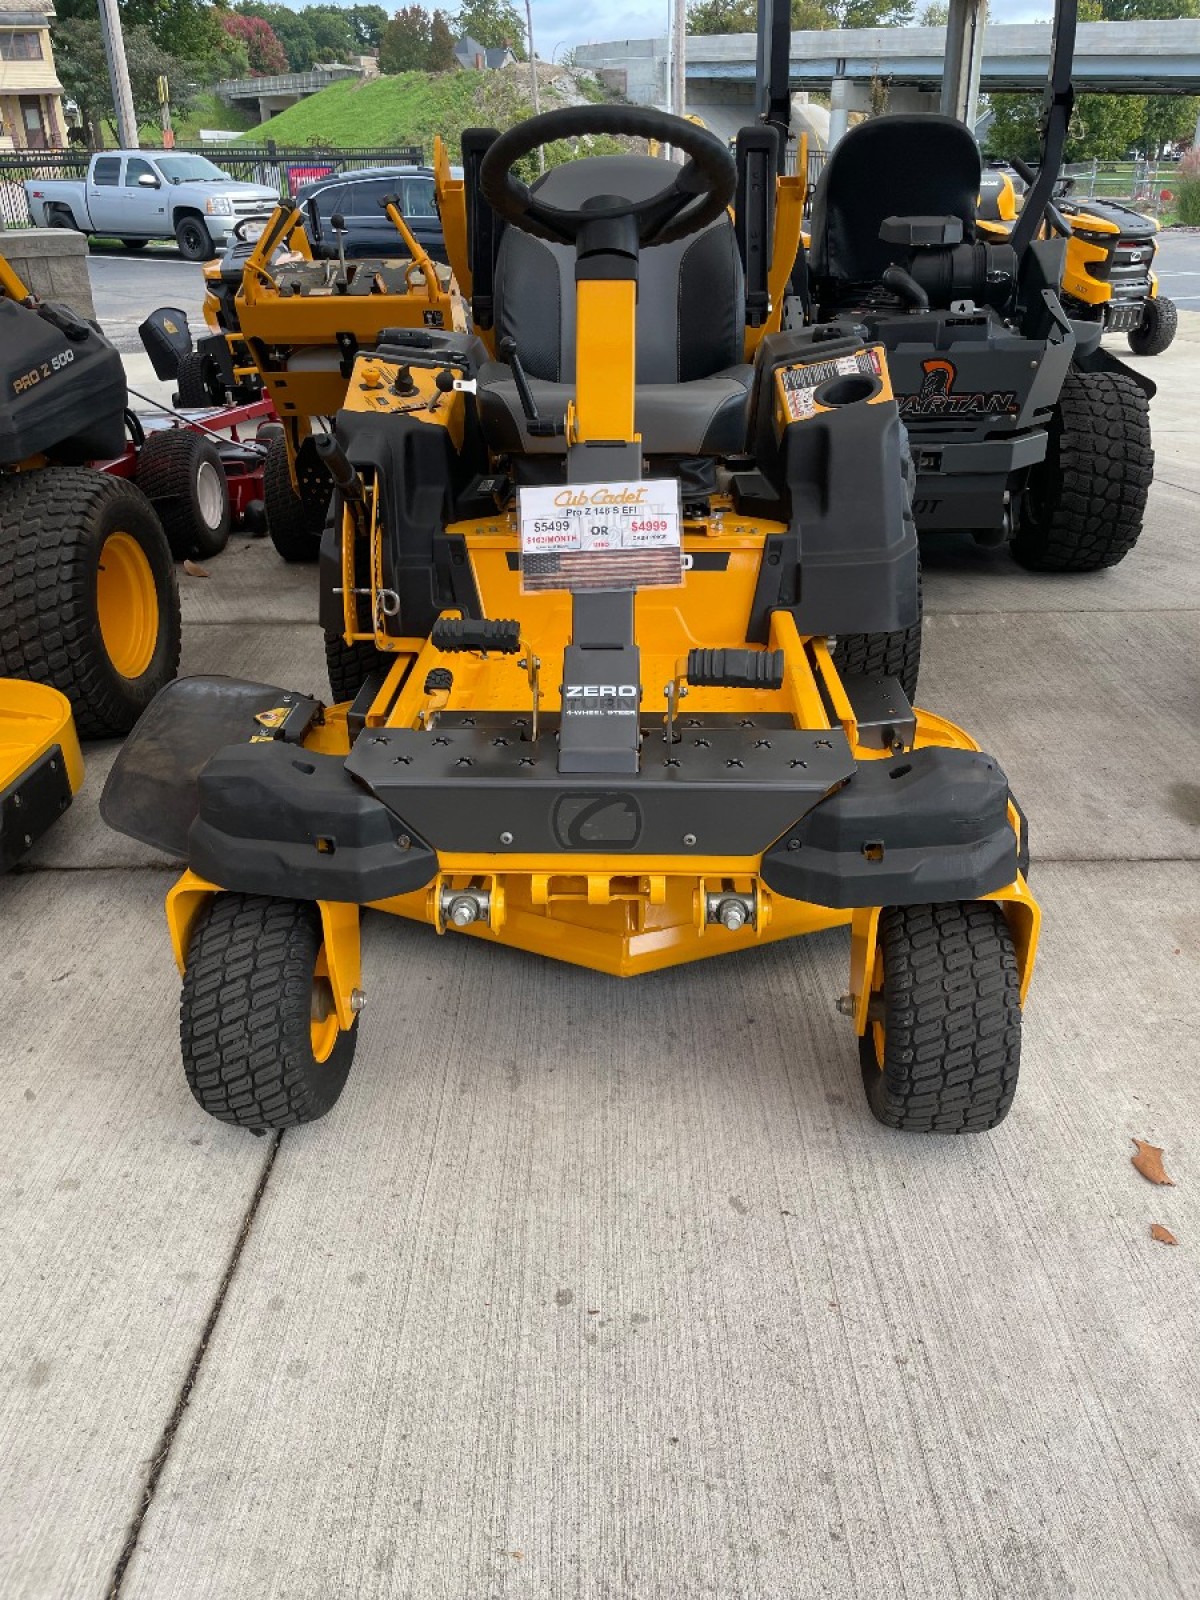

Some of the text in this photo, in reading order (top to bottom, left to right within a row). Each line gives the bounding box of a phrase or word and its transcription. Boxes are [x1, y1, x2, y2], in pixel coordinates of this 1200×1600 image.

[12, 348, 75, 394] PRO Z 500
[894, 394, 1015, 414] ARTAN
[554, 487, 649, 507] Cub Cadet
[566, 508, 582, 517] Pro
[584, 507, 592, 515] Z
[612, 506, 620, 514] S
[622, 506, 637, 514] EFI
[534, 520, 570, 533] $5499
[590, 526, 609, 536] OR
[631, 520, 668, 532] $4999
[566, 685, 638, 697] ZERO
[567, 697, 637, 710] TURN
